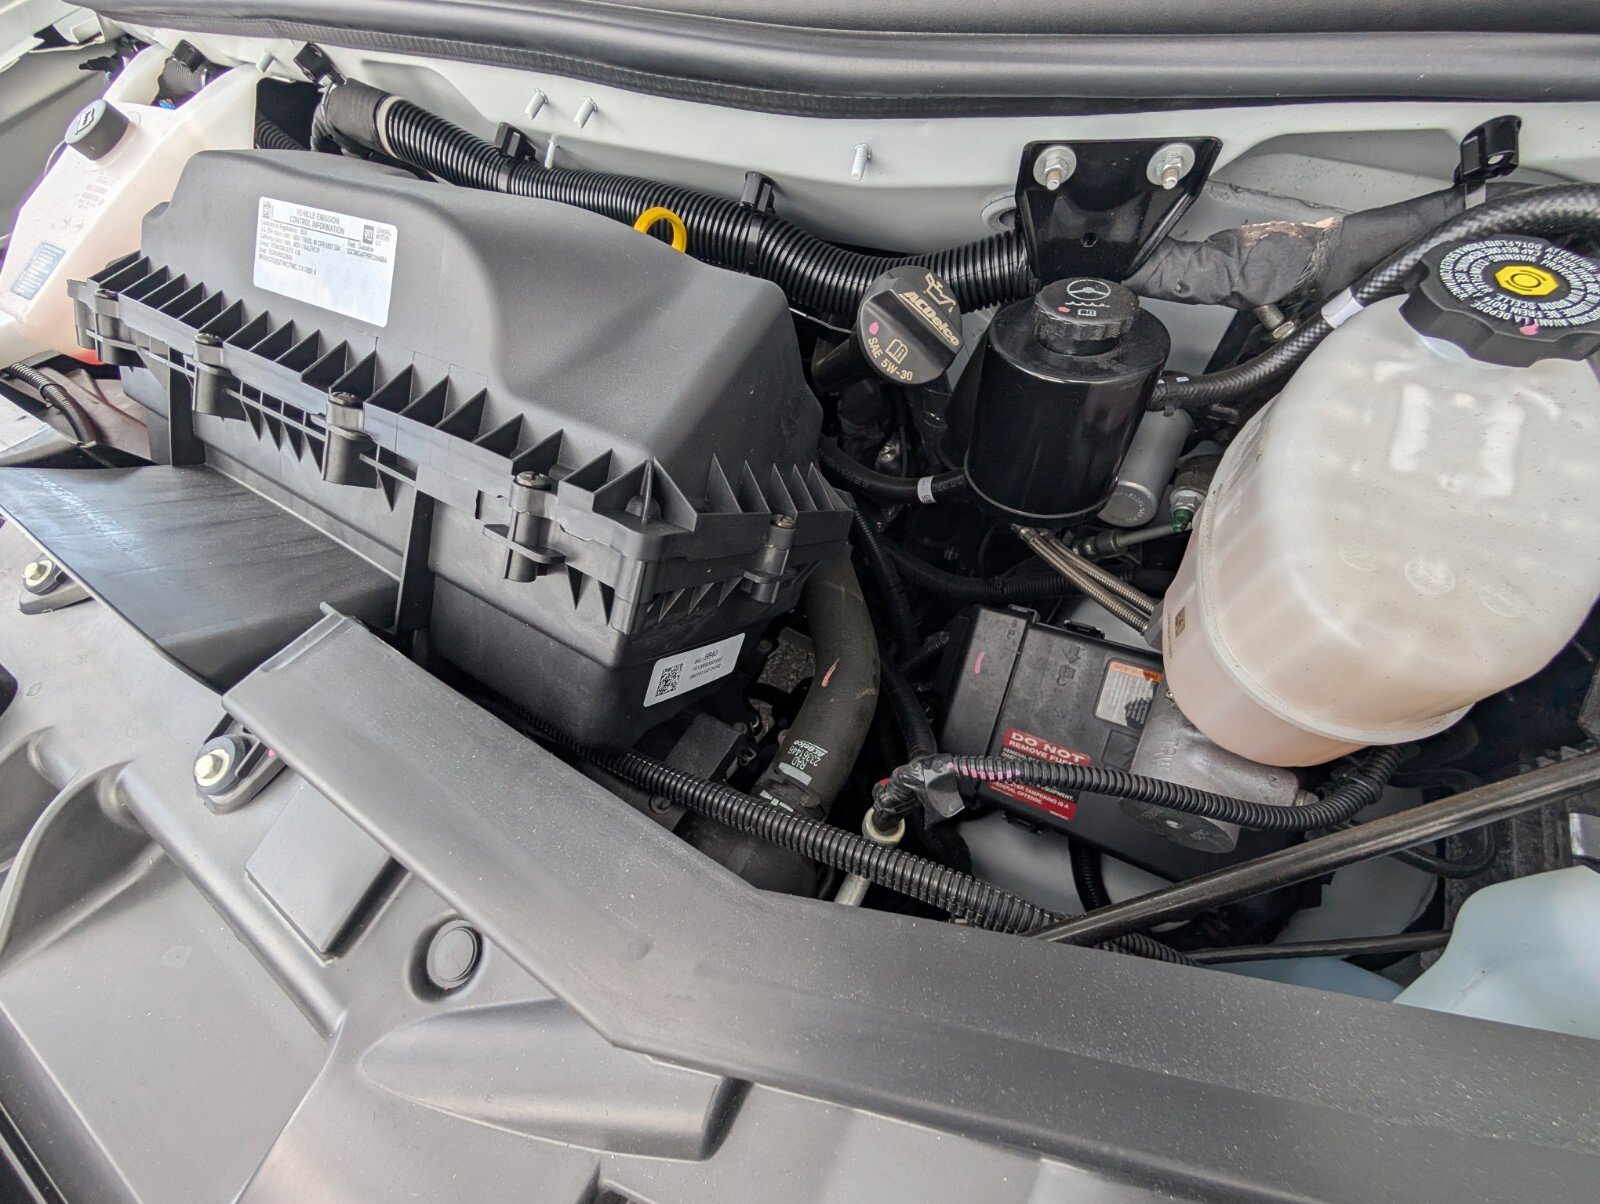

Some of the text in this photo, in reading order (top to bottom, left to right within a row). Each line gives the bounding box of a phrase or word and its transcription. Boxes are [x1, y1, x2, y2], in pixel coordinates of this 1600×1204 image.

[289, 215, 345, 235] CONTROL INFORMATION
[296, 208, 339, 225] VEHICLE EMISSION
[1459, 242, 1486, 252] FROM
[1480, 246, 1519, 255] BEFORE
[1521, 248, 1542, 256] CAP
[900, 291, 960, 346] ACDelco
[1508, 307, 1543, 318] FREIN
[1514, 315, 1529, 325] LA
[1544, 310, 1561, 318] DE
[869, 337, 913, 380] SAE 5W-30
[794, 740, 828, 757] ACDelco
[1009, 741, 1048, 758] REMOVE
[1011, 732, 1038, 747] DO
[1044, 743, 1084, 762] NOT
[788, 746, 821, 767] 23361446
[791, 756, 807, 770] RAD
[1025, 787, 1057, 805] TAMPERING
